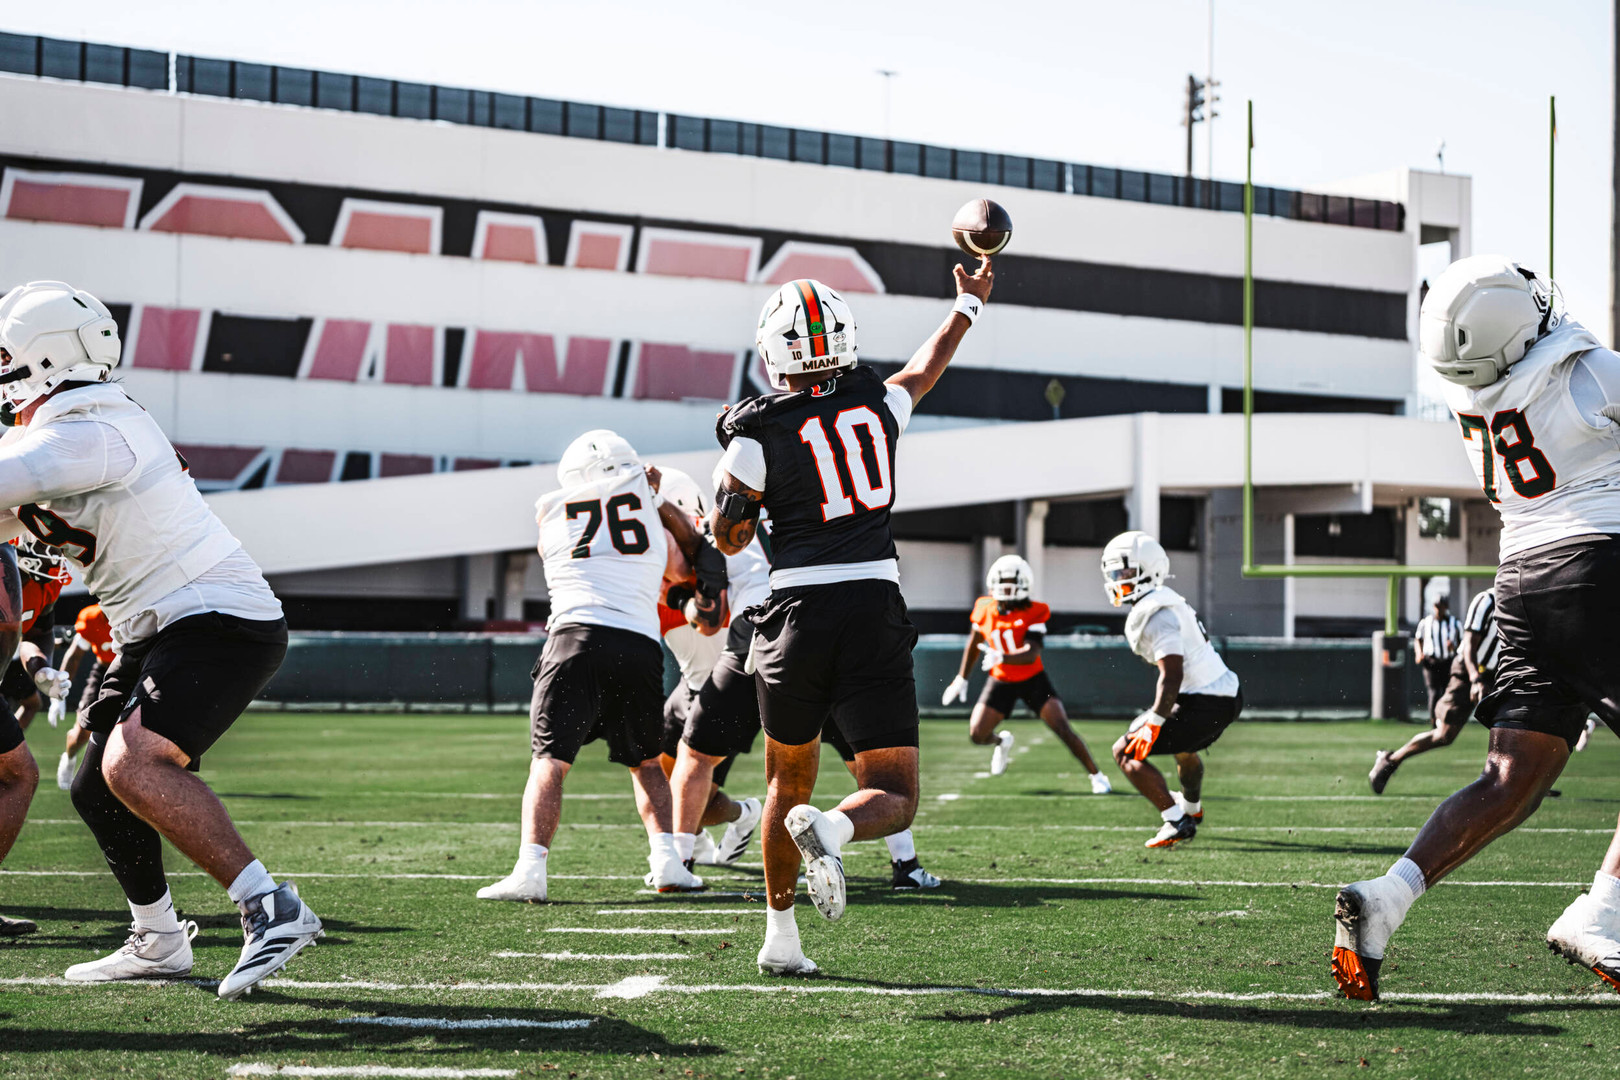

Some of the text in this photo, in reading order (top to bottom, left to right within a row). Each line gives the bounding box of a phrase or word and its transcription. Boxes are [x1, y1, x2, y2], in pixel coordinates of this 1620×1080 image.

[792, 351, 803, 361] 10
[802, 356, 839, 371] MIAMI
[798, 404, 893, 523] 10
[1457, 408, 1556, 503] 78
[565, 492, 650, 559] 76
[991, 629, 1017, 655] 11
